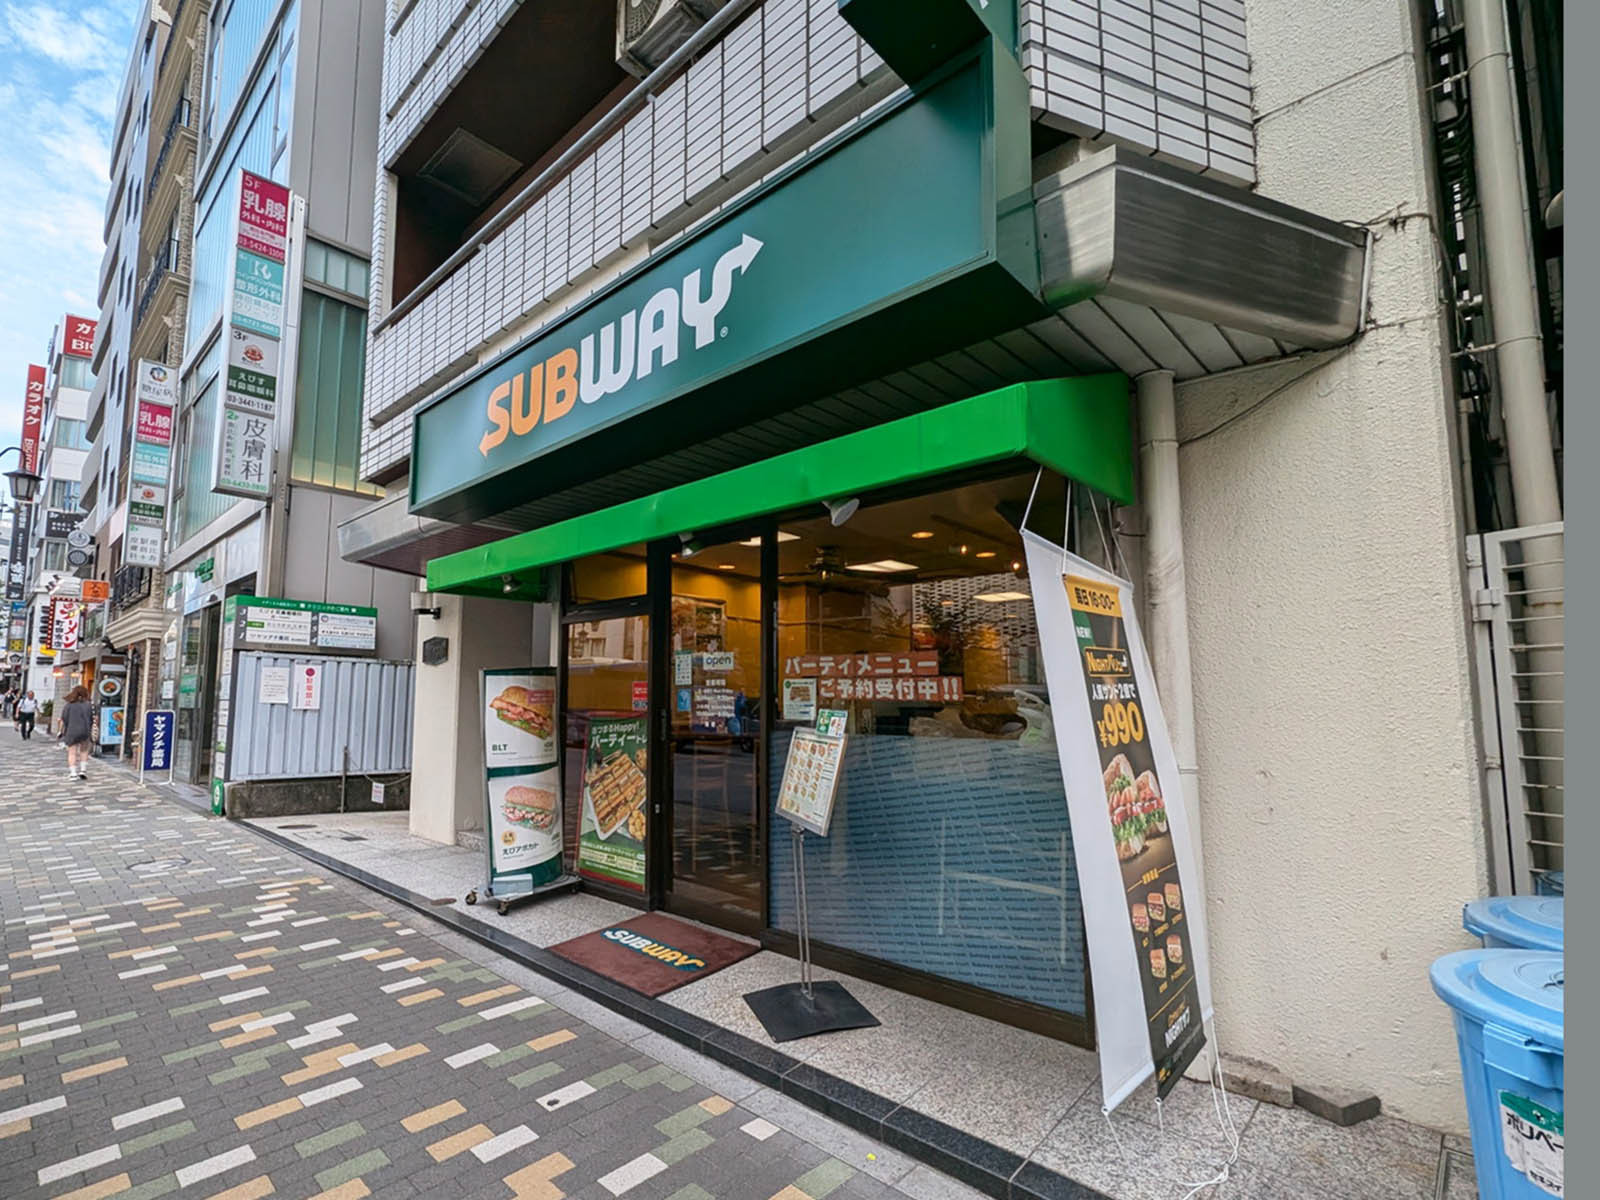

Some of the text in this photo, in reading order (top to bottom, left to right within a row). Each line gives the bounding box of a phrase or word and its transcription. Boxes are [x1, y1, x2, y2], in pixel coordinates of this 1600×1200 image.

[242, 188, 287, 222] 乳腺
[76, 322, 98, 335] カ
[479, 233, 764, 457] SUBWAY
[238, 371, 266, 386] えびす
[25, 381, 43, 426] カラオケ
[240, 418, 267, 482] 皮膚科
[705, 652, 732, 667] open
[784, 656, 937, 675] パーティメニュー
[819, 677, 959, 701] ご予約受付中!!
[150, 714, 167, 769] ヤマグチ薬局
[1097, 701, 1144, 748] ¥990
[491, 743, 508, 752] BLT
[604, 930, 705, 968] SUBWAY
